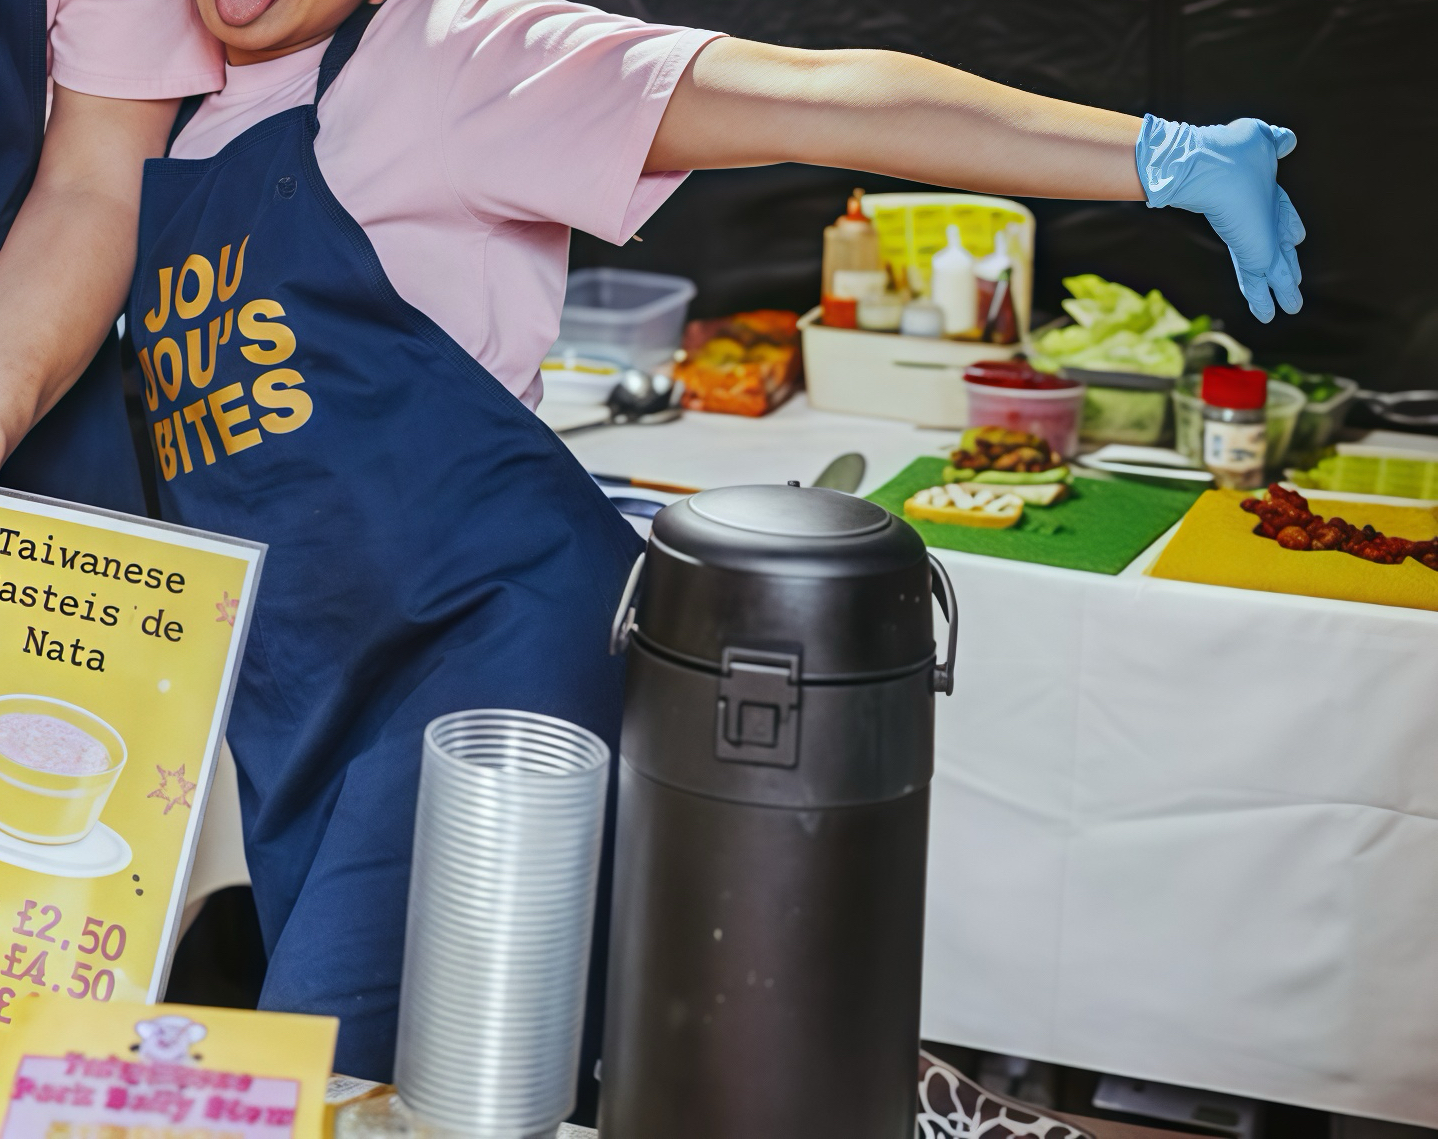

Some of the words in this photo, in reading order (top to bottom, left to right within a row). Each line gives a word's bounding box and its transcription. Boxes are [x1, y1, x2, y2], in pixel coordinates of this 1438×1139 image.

[144, 234, 250, 332] JOU
[138, 298, 296, 411] JOU'S
[154, 368, 313, 481] BITES
[0, 528, 185, 594] Taiwanese
[22, 626, 106, 673] Nata
[141, 609, 184, 642] de
[12, 899, 127, 961] £2.50
[0, 943, 115, 1002] £4.50
